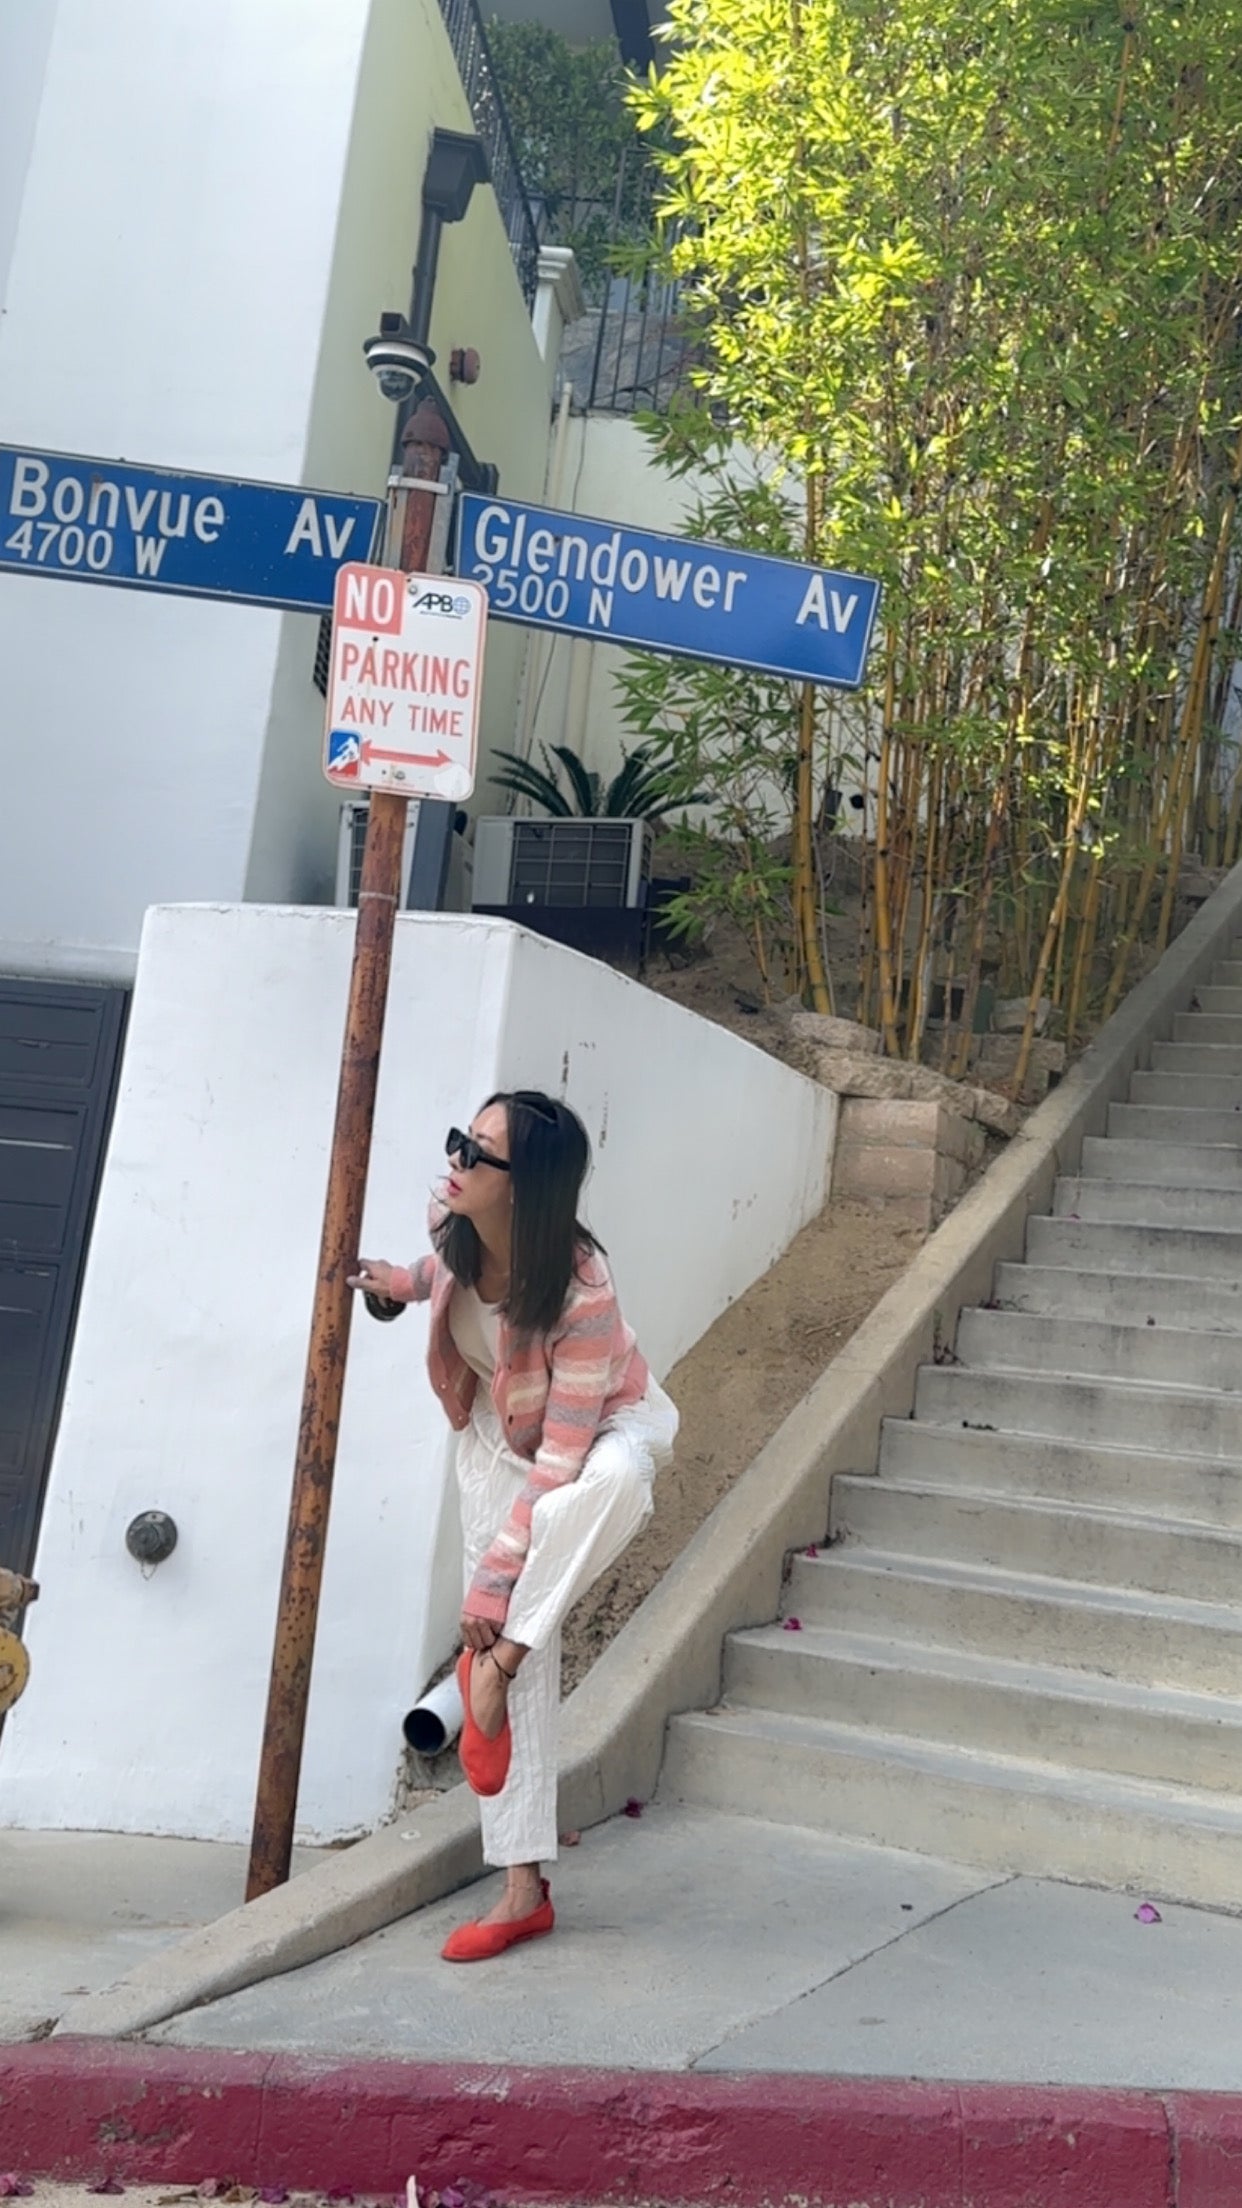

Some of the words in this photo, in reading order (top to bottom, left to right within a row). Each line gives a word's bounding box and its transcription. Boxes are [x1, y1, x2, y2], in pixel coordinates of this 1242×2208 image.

[10, 457, 225, 543] Bonvue
[284, 498, 355, 559] Av
[5, 520, 113, 571] 4700
[135, 534, 167, 577] W
[474, 505, 747, 613] Glendower
[795, 574, 858, 634] Av
[344, 574, 395, 625] NO
[588, 587, 613, 628] N
[340, 642, 471, 699] PARKING
[341, 695, 394, 727] ANY
[408, 704, 464, 738] TIME
